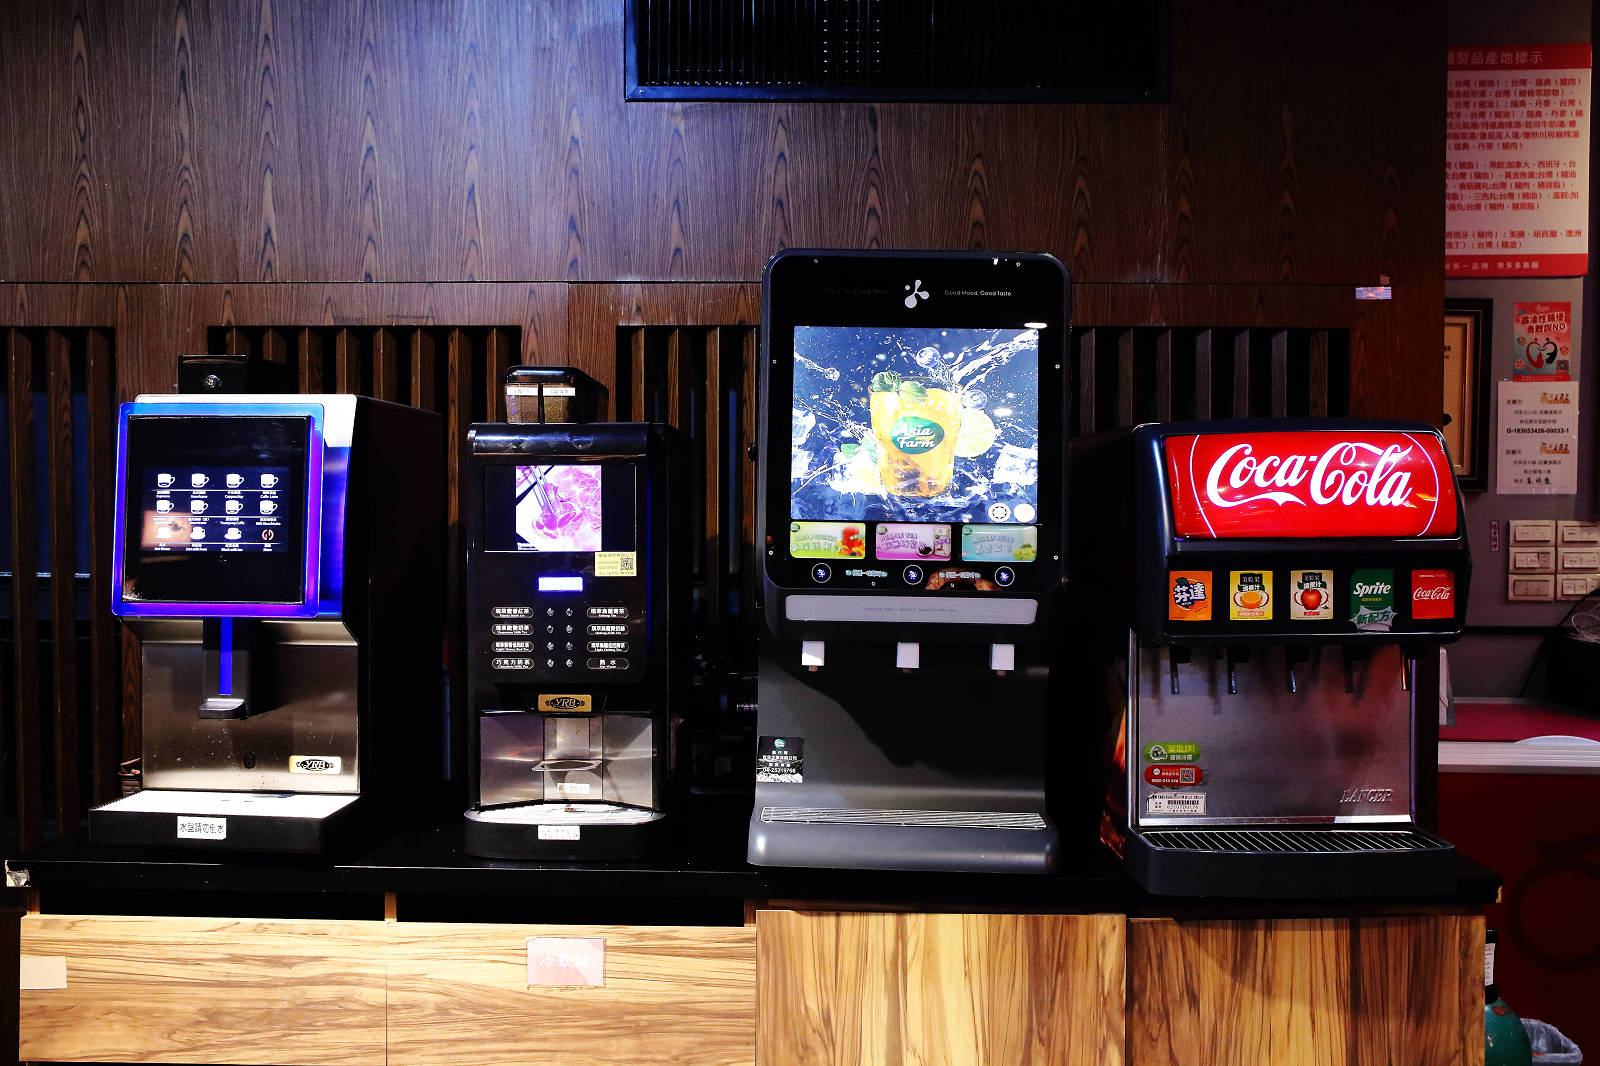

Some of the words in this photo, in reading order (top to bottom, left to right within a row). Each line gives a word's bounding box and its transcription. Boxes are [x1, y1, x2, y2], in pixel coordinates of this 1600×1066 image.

[1527, 321, 1567, 335] 勇敢說NO
[893, 423, 931, 438] Asia
[896, 435, 935, 449] Farm
[1205, 441, 1414, 508] Coca-Cola
[1173, 582, 1206, 604] 芬達
[1353, 581, 1392, 598] Sprite
[1413, 586, 1452, 601] Coca-Cola
[1357, 609, 1392, 625] 新配方
[553, 698, 577, 708] YRB
[302, 759, 328, 770] YRB
[1339, 789, 1393, 803] LANCER
